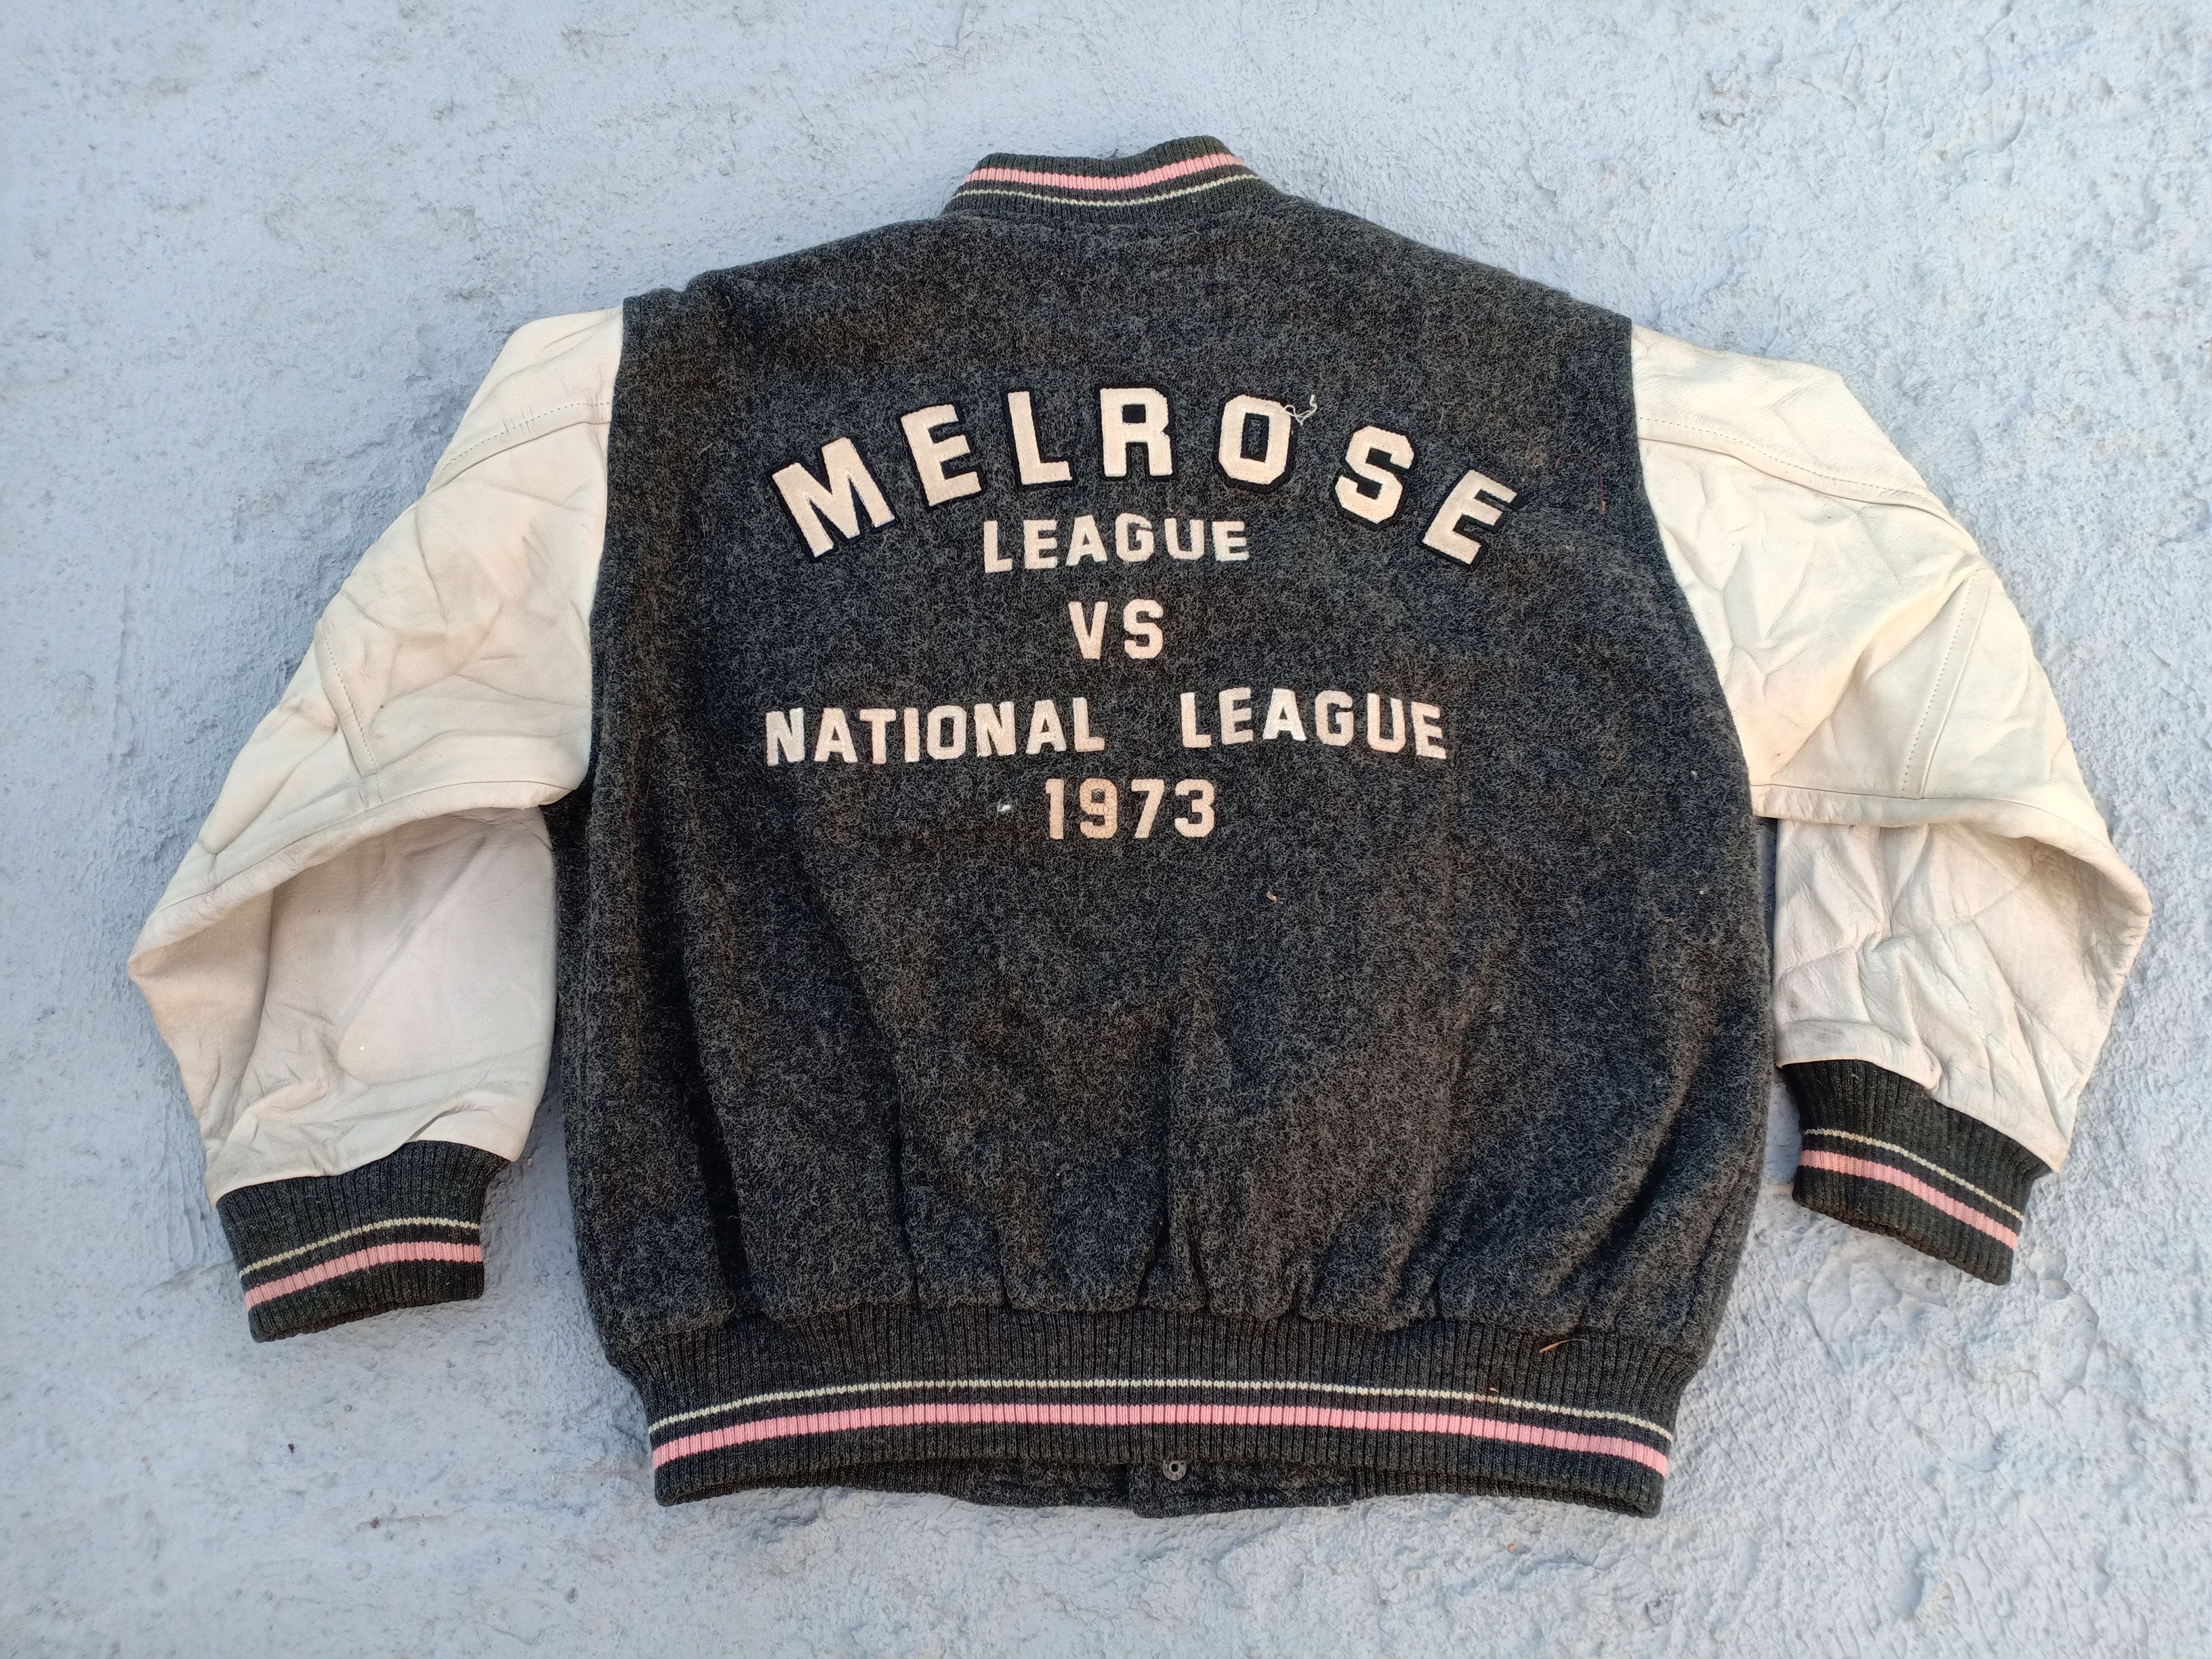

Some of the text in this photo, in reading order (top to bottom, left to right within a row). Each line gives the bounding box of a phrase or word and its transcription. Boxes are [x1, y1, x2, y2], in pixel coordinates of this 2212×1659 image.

[771, 386, 1519, 566] MELROSE
[983, 512, 1250, 574] LEAGUE
[1067, 598, 1165, 661] VS
[764, 686, 1448, 766] NATIONAL LEAGUE
[1044, 777, 1216, 840] 1973
